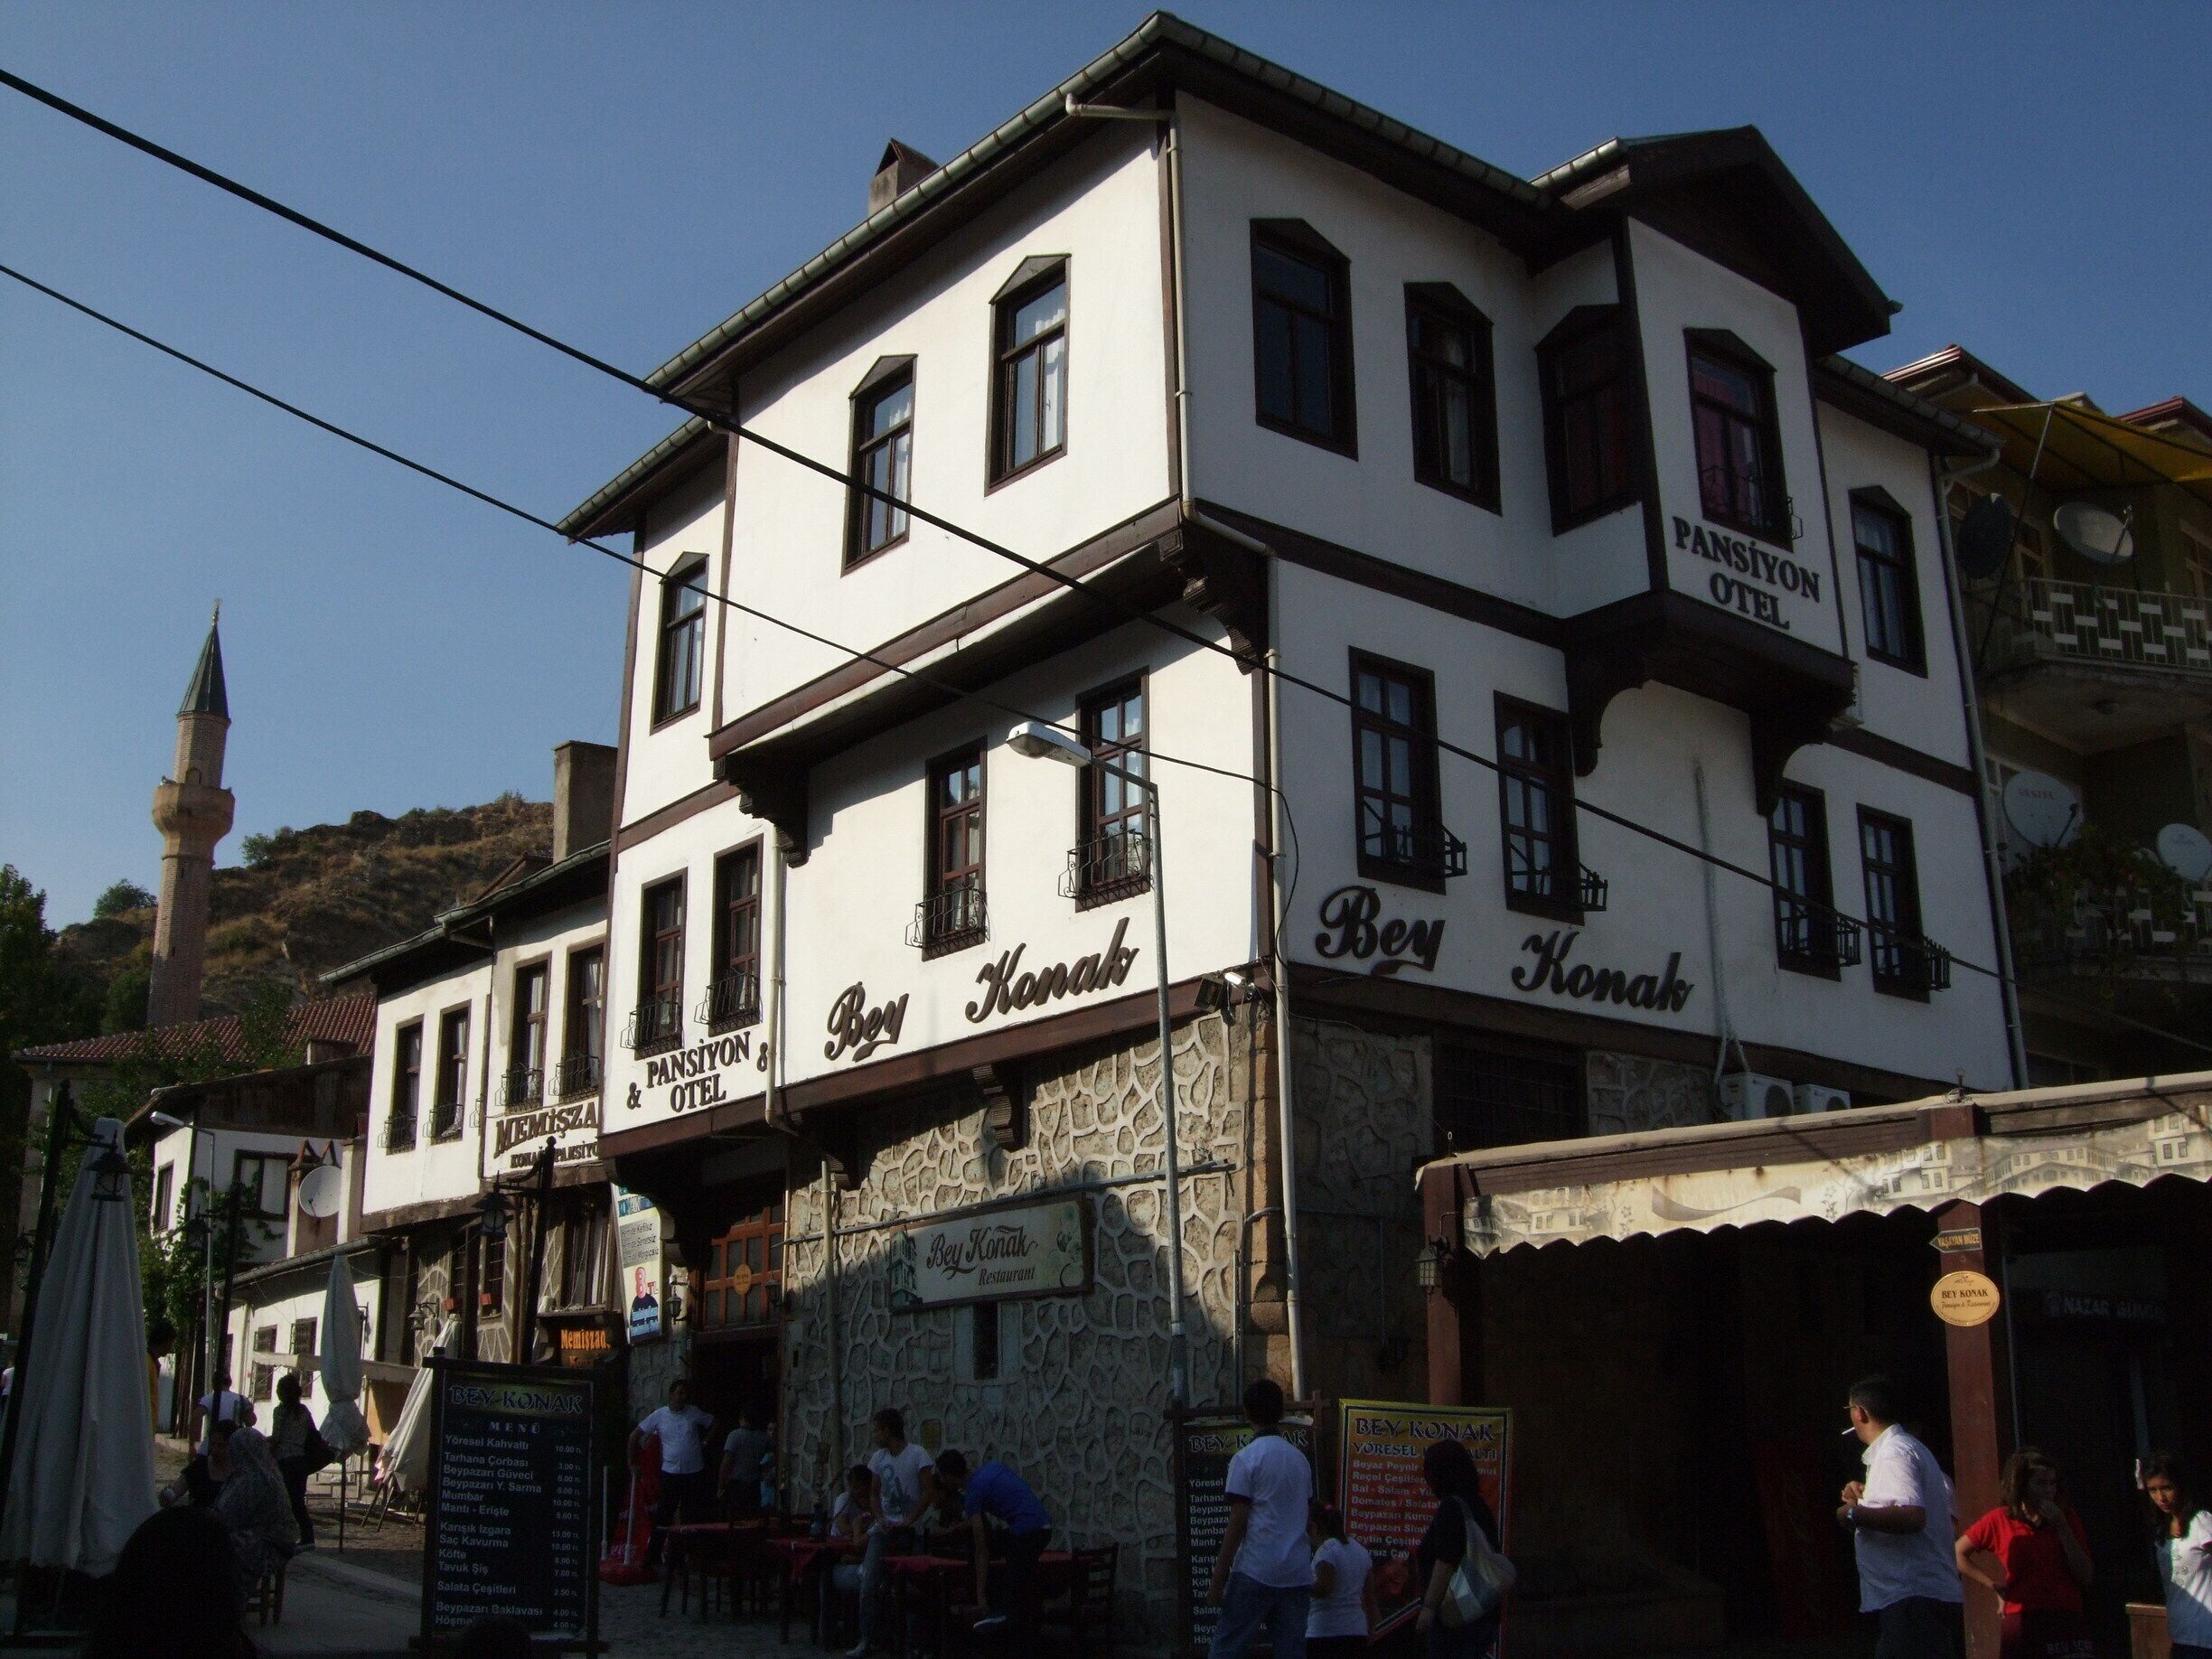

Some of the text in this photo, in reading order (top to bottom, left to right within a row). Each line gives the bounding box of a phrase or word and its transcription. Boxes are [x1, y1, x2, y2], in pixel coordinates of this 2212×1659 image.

[1672, 515, 1821, 604] PANSİYON
[1710, 572, 1790, 630] OTEL
[1315, 885, 1695, 1013] Bey Konak
[824, 916, 1140, 1063] Bey Konak
[646, 1030, 751, 1089] PANSİYON
[670, 1073, 726, 1113] OTEL
[927, 1224, 1038, 1279] Bey Konak
[635, 1266, 646, 1299] 8
[979, 1267, 1036, 1286] Restaurant
[1942, 1289, 1988, 1299] BEY KONAK
[451, 1384, 583, 1415] BEY KONAK
[489, 1420, 541, 1435] MENÜ
[1355, 1418, 1494, 1441] BEY KONAK
[445, 1434, 530, 1450] Yöresel Kahvaltı
[1189, 1434, 1229, 1452] BEY
[1354, 1441, 1420, 1456] YÖRESEL
[444, 1451, 529, 1467] Tarhana Çorbası
[1352, 1459, 1383, 1470] Beyaz
[1386, 1461, 1419, 1472] Peynir
[443, 1464, 534, 1480] Beypazarı Güveci
[1352, 1471, 1382, 1483] Reçel
[442, 1476, 493, 1490] Beypazarı
[508, 1482, 542, 1494] Sarma
[1189, 1478, 1223, 1487] Yöresel
[1352, 1484, 1369, 1493] Bal
[1377, 1485, 1410, 1495] Salam
[442, 1489, 484, 1502] Mumbar
[1351, 1496, 1397, 1507] Domates
[441, 1503, 470, 1514] Mantı
[479, 1505, 511, 1518] Erişte
[439, 1534, 509, 1549] Saç Kavurma
[438, 1549, 467, 1560] Köfte
[1391, 1549, 1410, 1560] Çay
[438, 1561, 489, 1576] Tavuk Şiş
[1192, 1566, 1209, 1575] Saç
[436, 1580, 517, 1596] Salata Çeşitleri
[436, 1601, 489, 1615] Beypazarı
